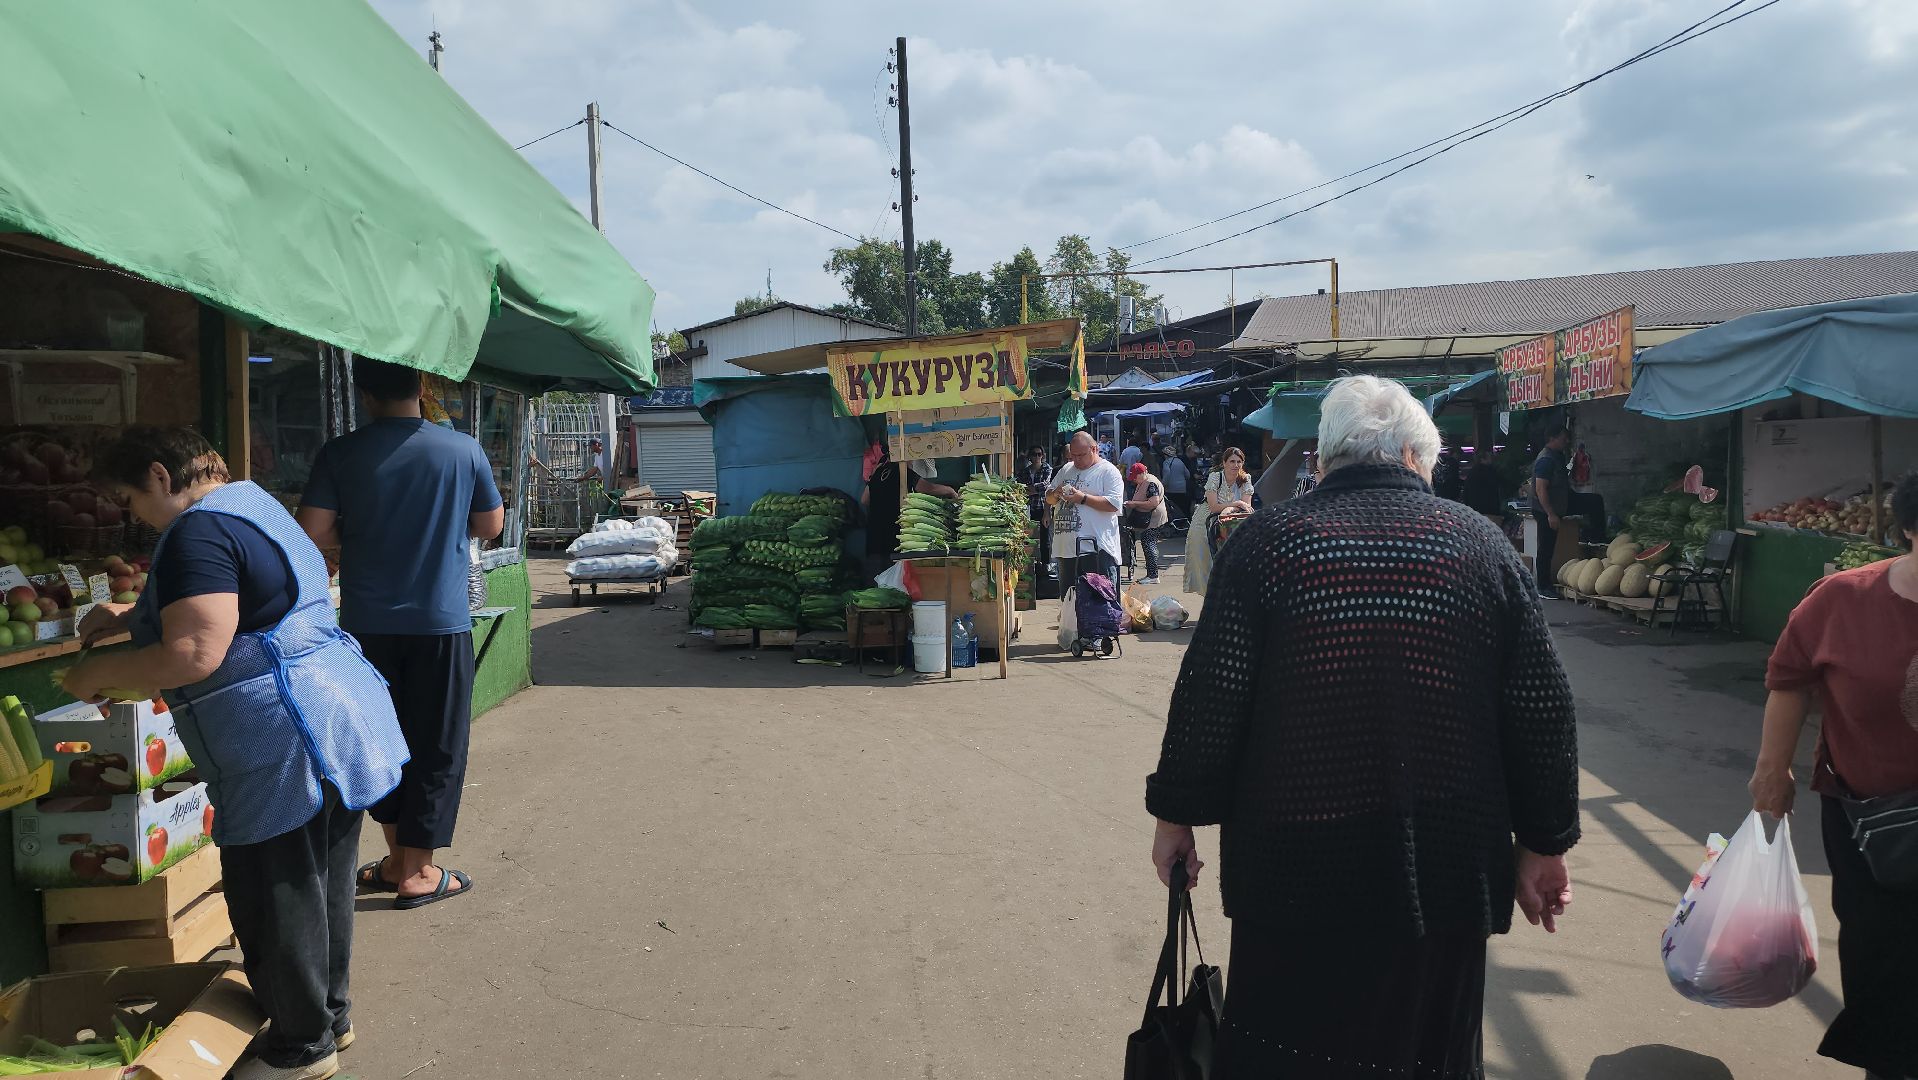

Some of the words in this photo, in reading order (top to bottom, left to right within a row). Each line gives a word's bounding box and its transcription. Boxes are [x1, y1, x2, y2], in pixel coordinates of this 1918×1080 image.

[1119, 339, 1195, 361] МЯСО
[1563, 312, 1621, 360] АРБУЗЫ
[1503, 338, 1546, 374] АРБУЗЫ
[845, 350, 1017, 401] КУКУРУЗА
[1508, 373, 1542, 410] ДЫНИ
[1568, 355, 1614, 400] ДЫНИ
[169, 791, 201, 825] Apples
